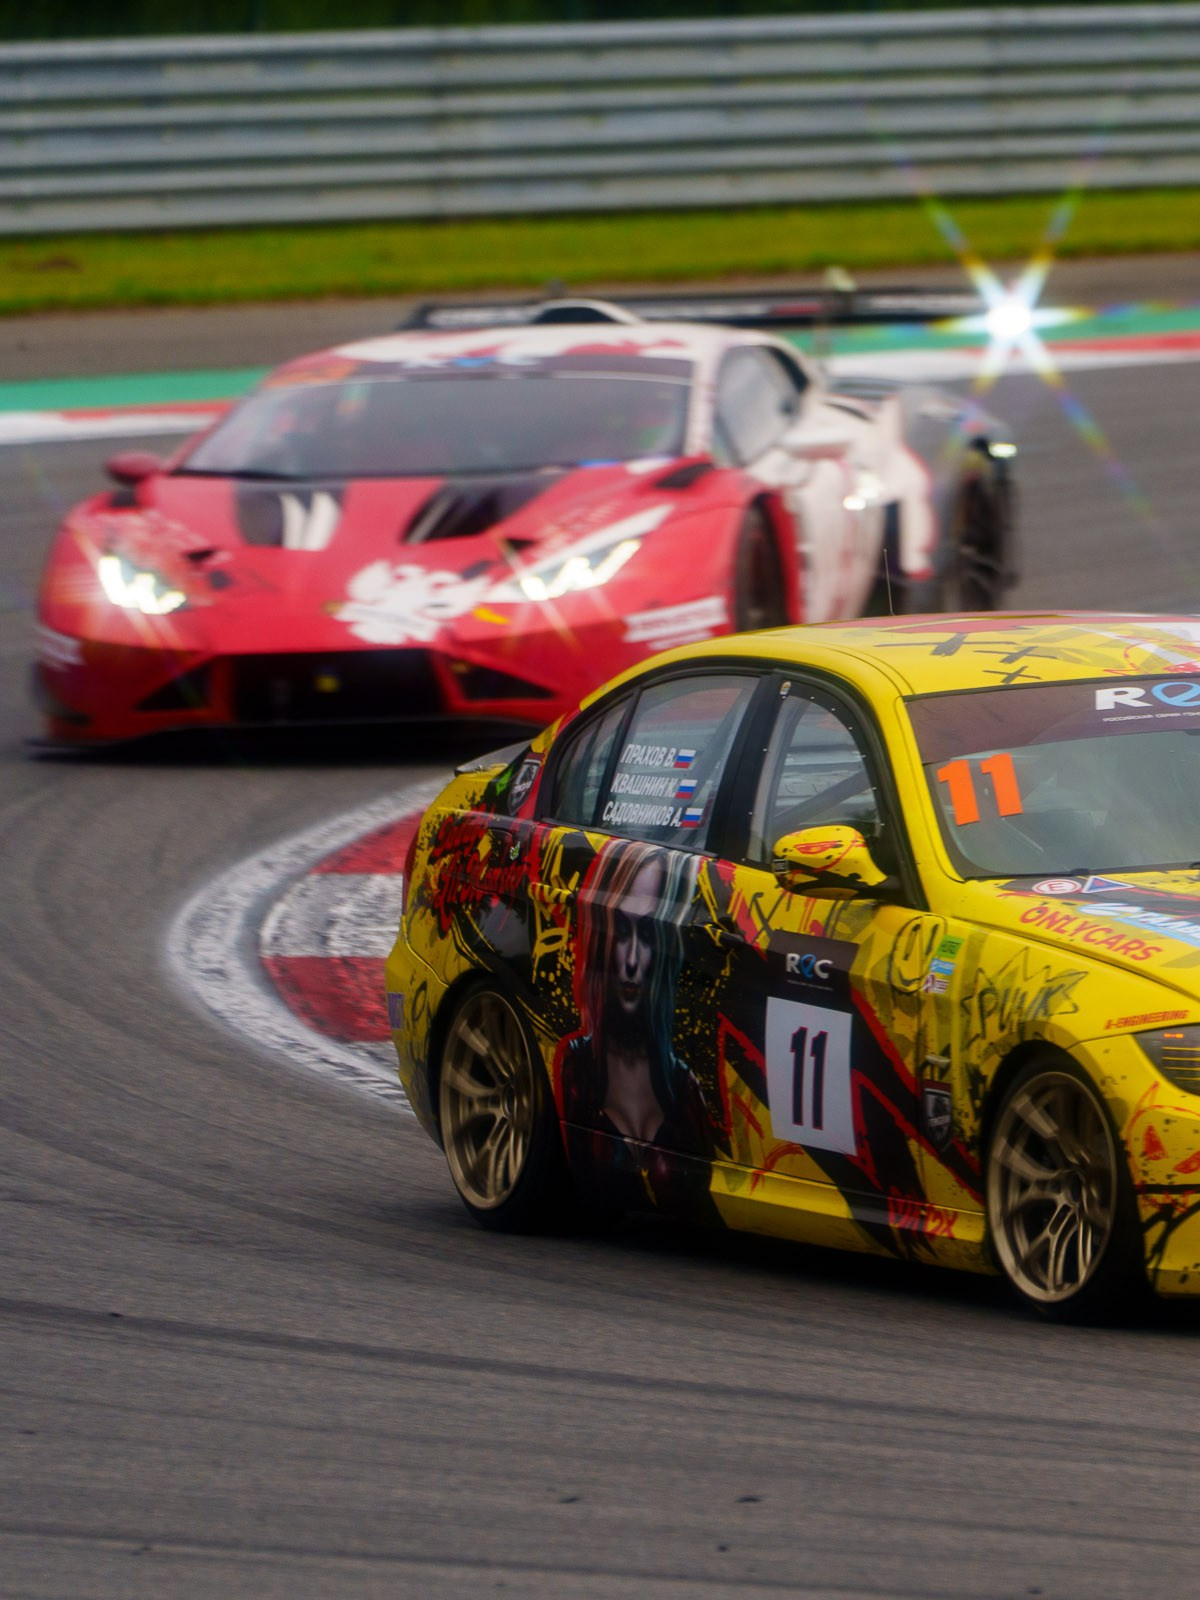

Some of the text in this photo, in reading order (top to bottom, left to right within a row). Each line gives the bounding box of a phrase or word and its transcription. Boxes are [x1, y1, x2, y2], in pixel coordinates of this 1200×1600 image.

[620, 744, 665, 766] ПРАХОВ
[610, 773, 666, 796] КВАШНИН
[937, 753, 1023, 826] 11
[602, 801, 673, 826] САДОВНИКОВ
[1020, 906, 1163, 961] ONLYCARS
[790, 1026, 829, 1131] 11
